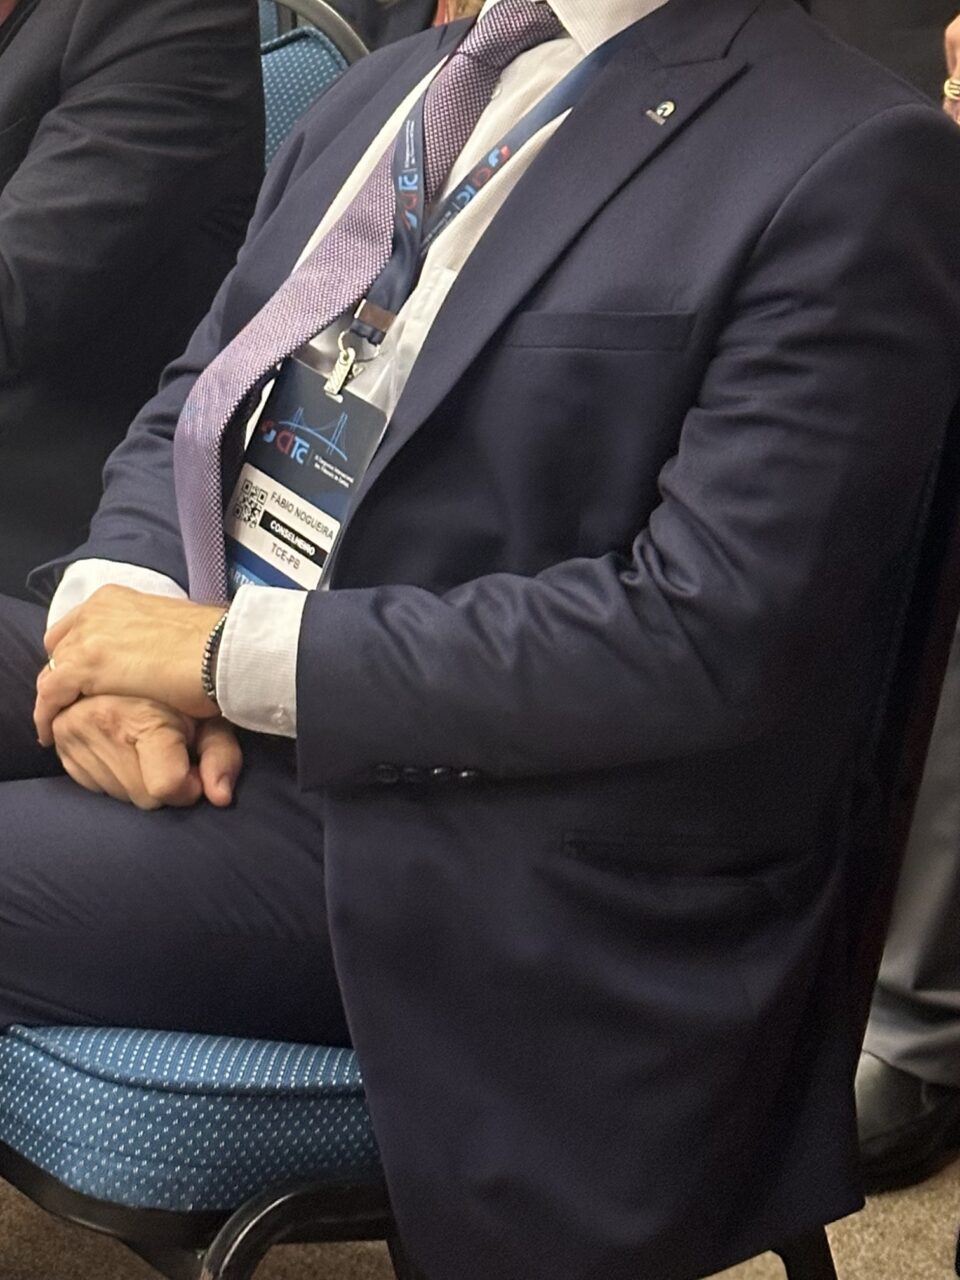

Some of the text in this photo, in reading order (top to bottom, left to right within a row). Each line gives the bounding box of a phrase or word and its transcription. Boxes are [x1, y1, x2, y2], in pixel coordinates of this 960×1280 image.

[270, 520, 316, 556] CONSELHEIRO
[294, 507, 334, 540] NOGUEIRA
[270, 542, 301, 570] TCE-PB
